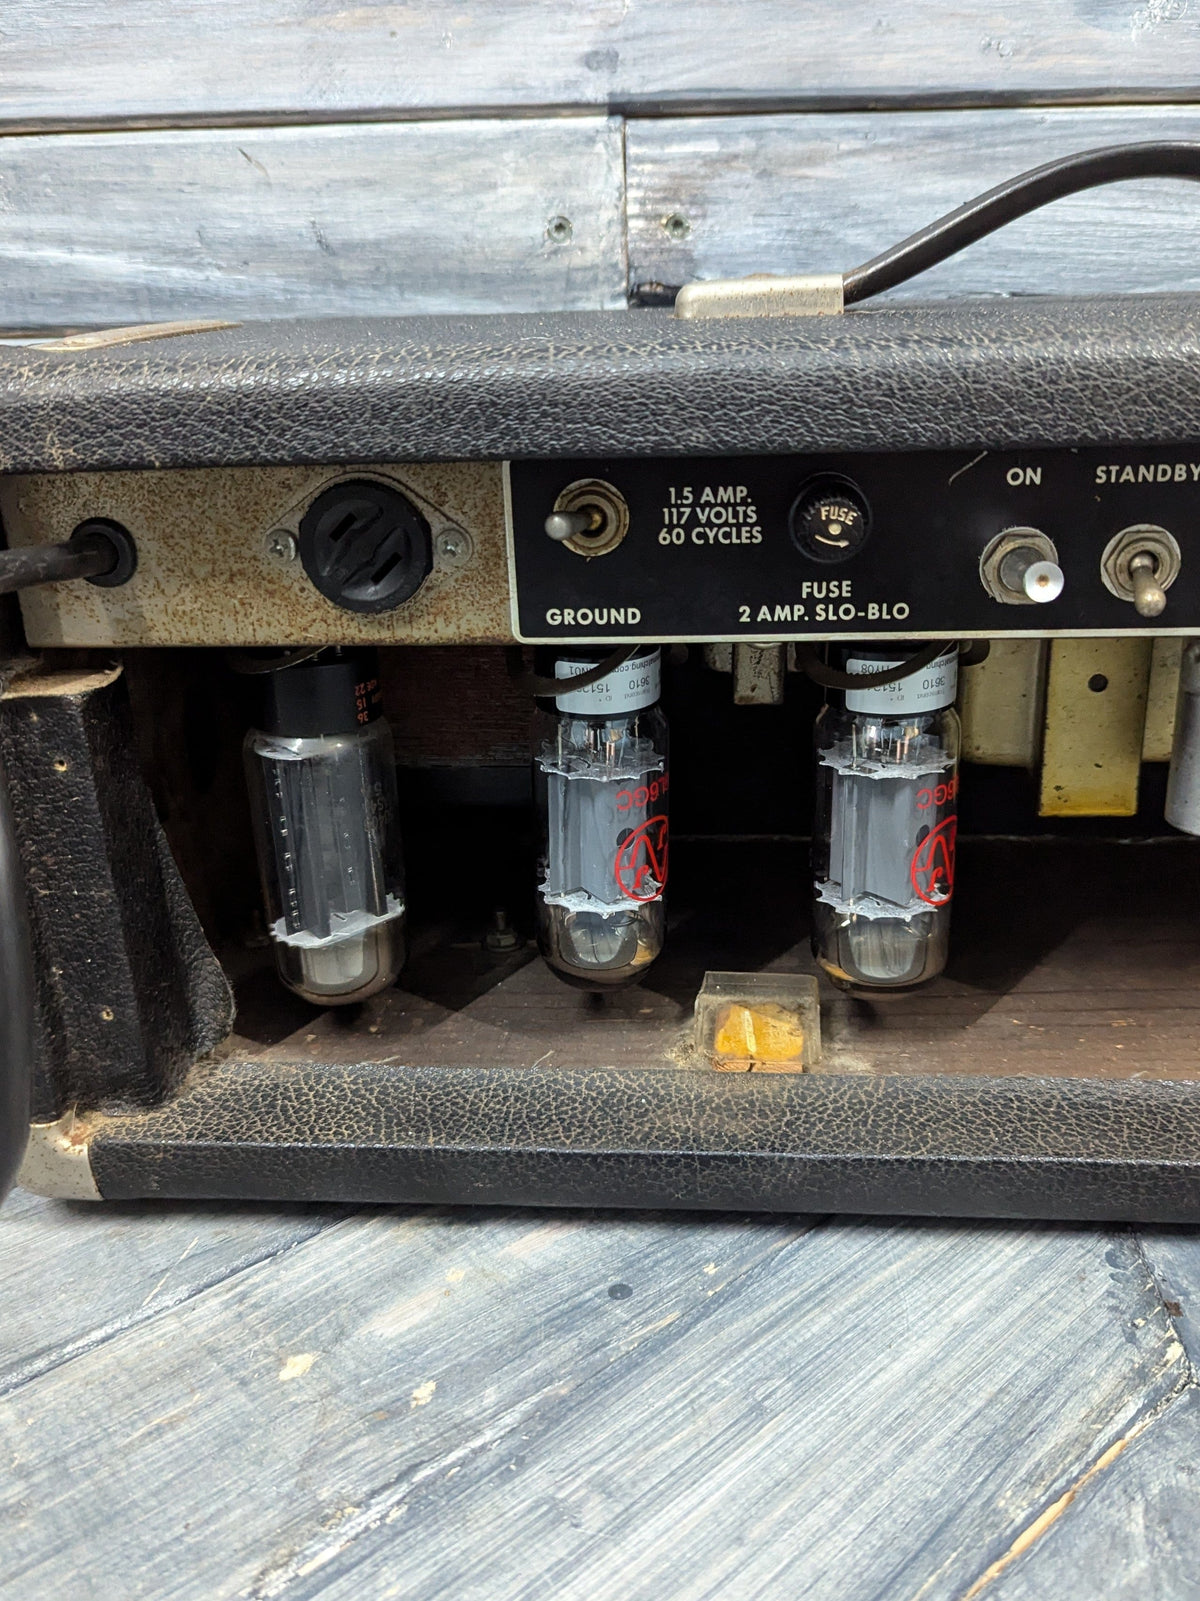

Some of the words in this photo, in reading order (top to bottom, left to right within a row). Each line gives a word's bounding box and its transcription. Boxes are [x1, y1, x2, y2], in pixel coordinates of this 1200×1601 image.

[1006, 467, 1042, 486] ON
[1095, 463, 1200, 484] STANDBY
[668, 486, 693, 505] 1.5
[700, 486, 752, 504] AMP.
[662, 507, 690, 525] 117
[699, 505, 758, 524] VOLTS
[820, 506, 857, 526] FUSE
[658, 527, 685, 546] 60
[691, 526, 762, 545] CYCLES
[801, 580, 852, 599] FUSE
[545, 607, 642, 626] GROUND
[738, 606, 751, 623] 2
[757, 604, 809, 622] AMP.
[815, 602, 910, 622] SLO-BLO
